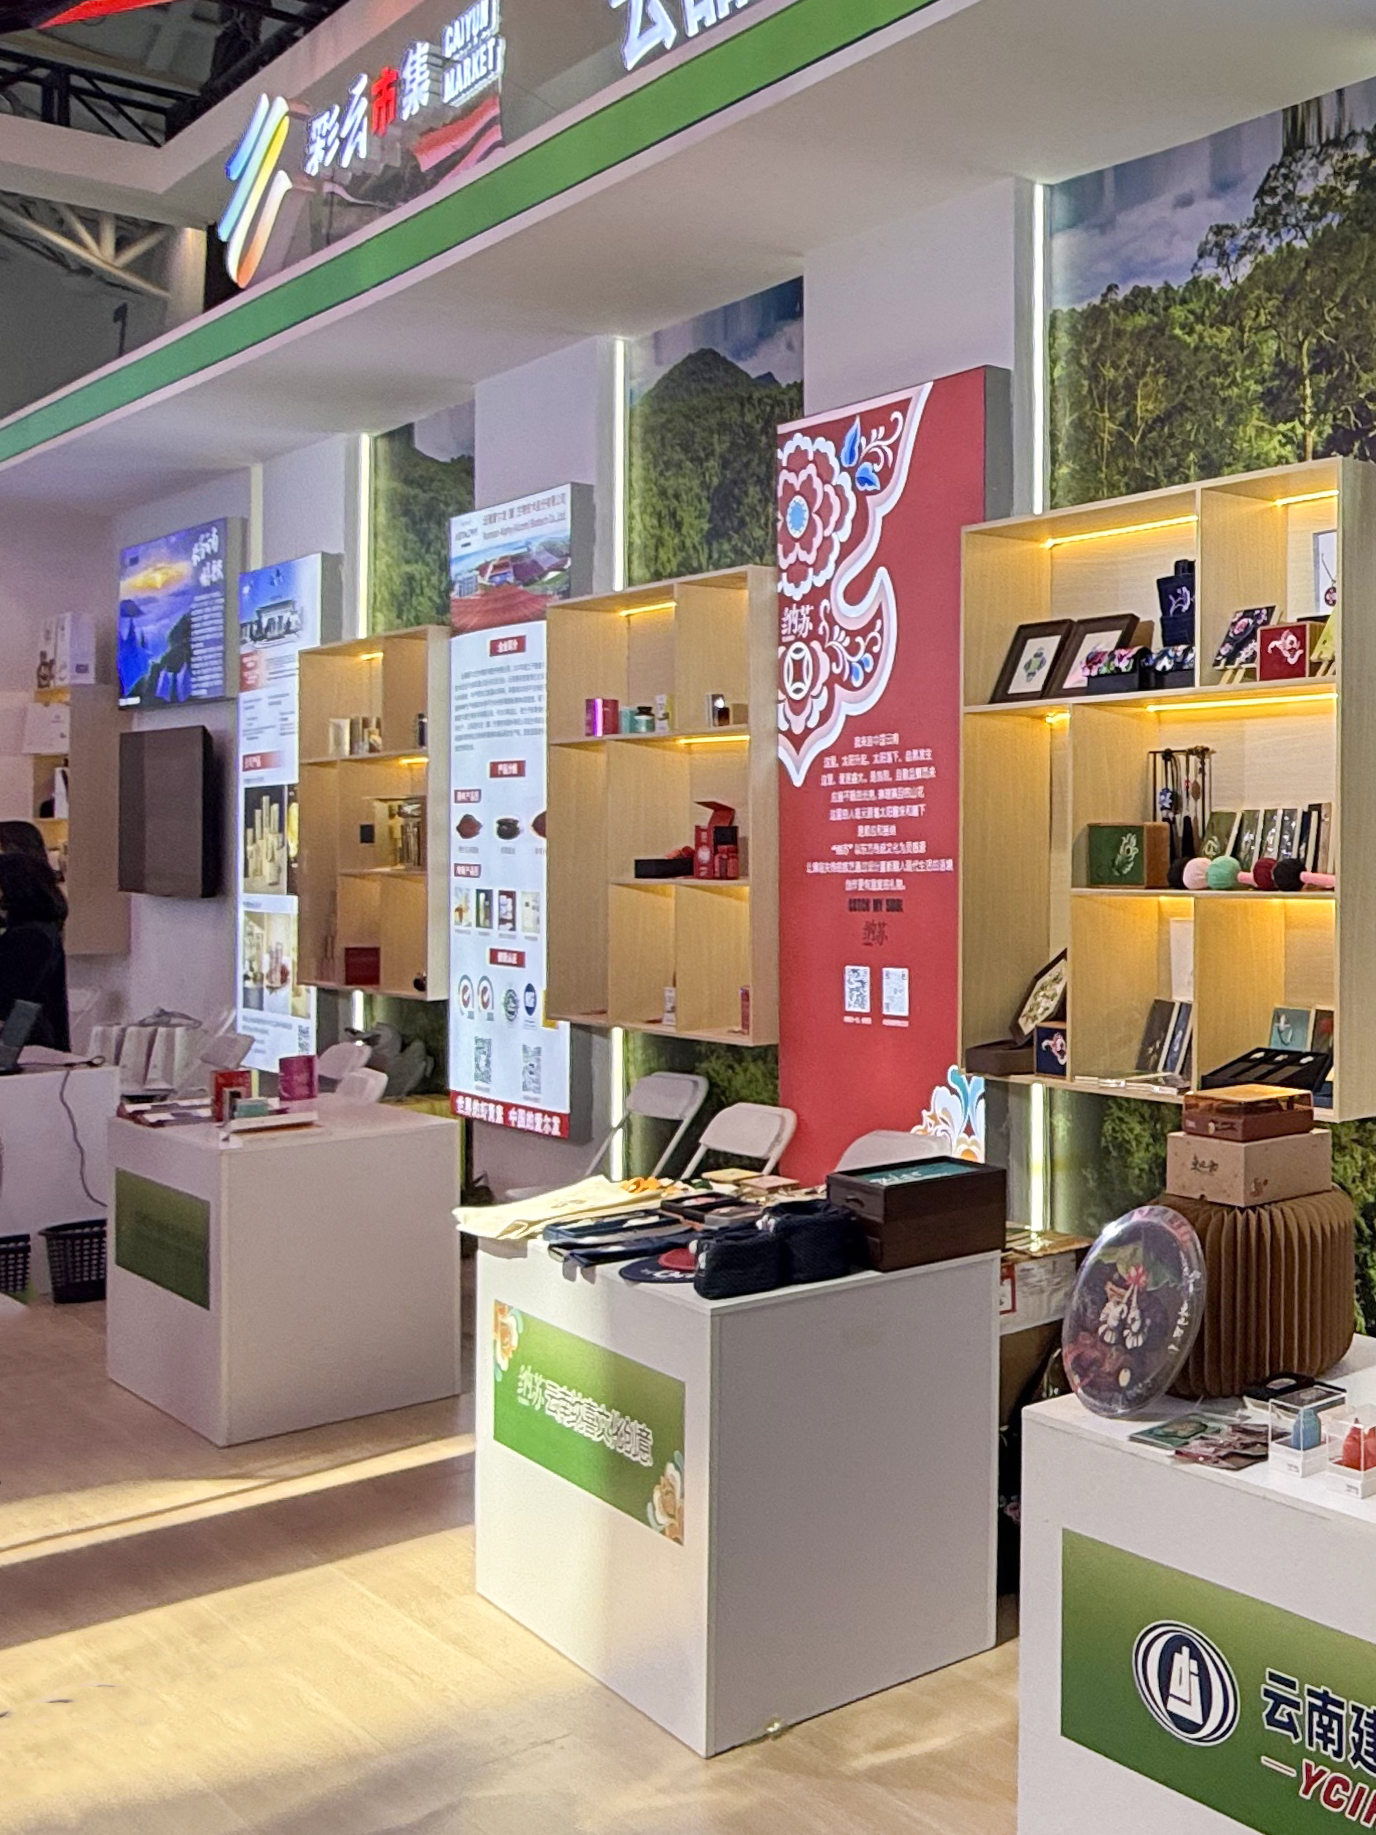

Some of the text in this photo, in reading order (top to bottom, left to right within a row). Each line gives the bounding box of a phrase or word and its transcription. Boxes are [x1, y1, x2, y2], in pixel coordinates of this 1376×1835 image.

[443, 0, 497, 58] CAIYUN
[443, 41, 501, 103] MARKET
[303, 40, 432, 177] 彩云市集
